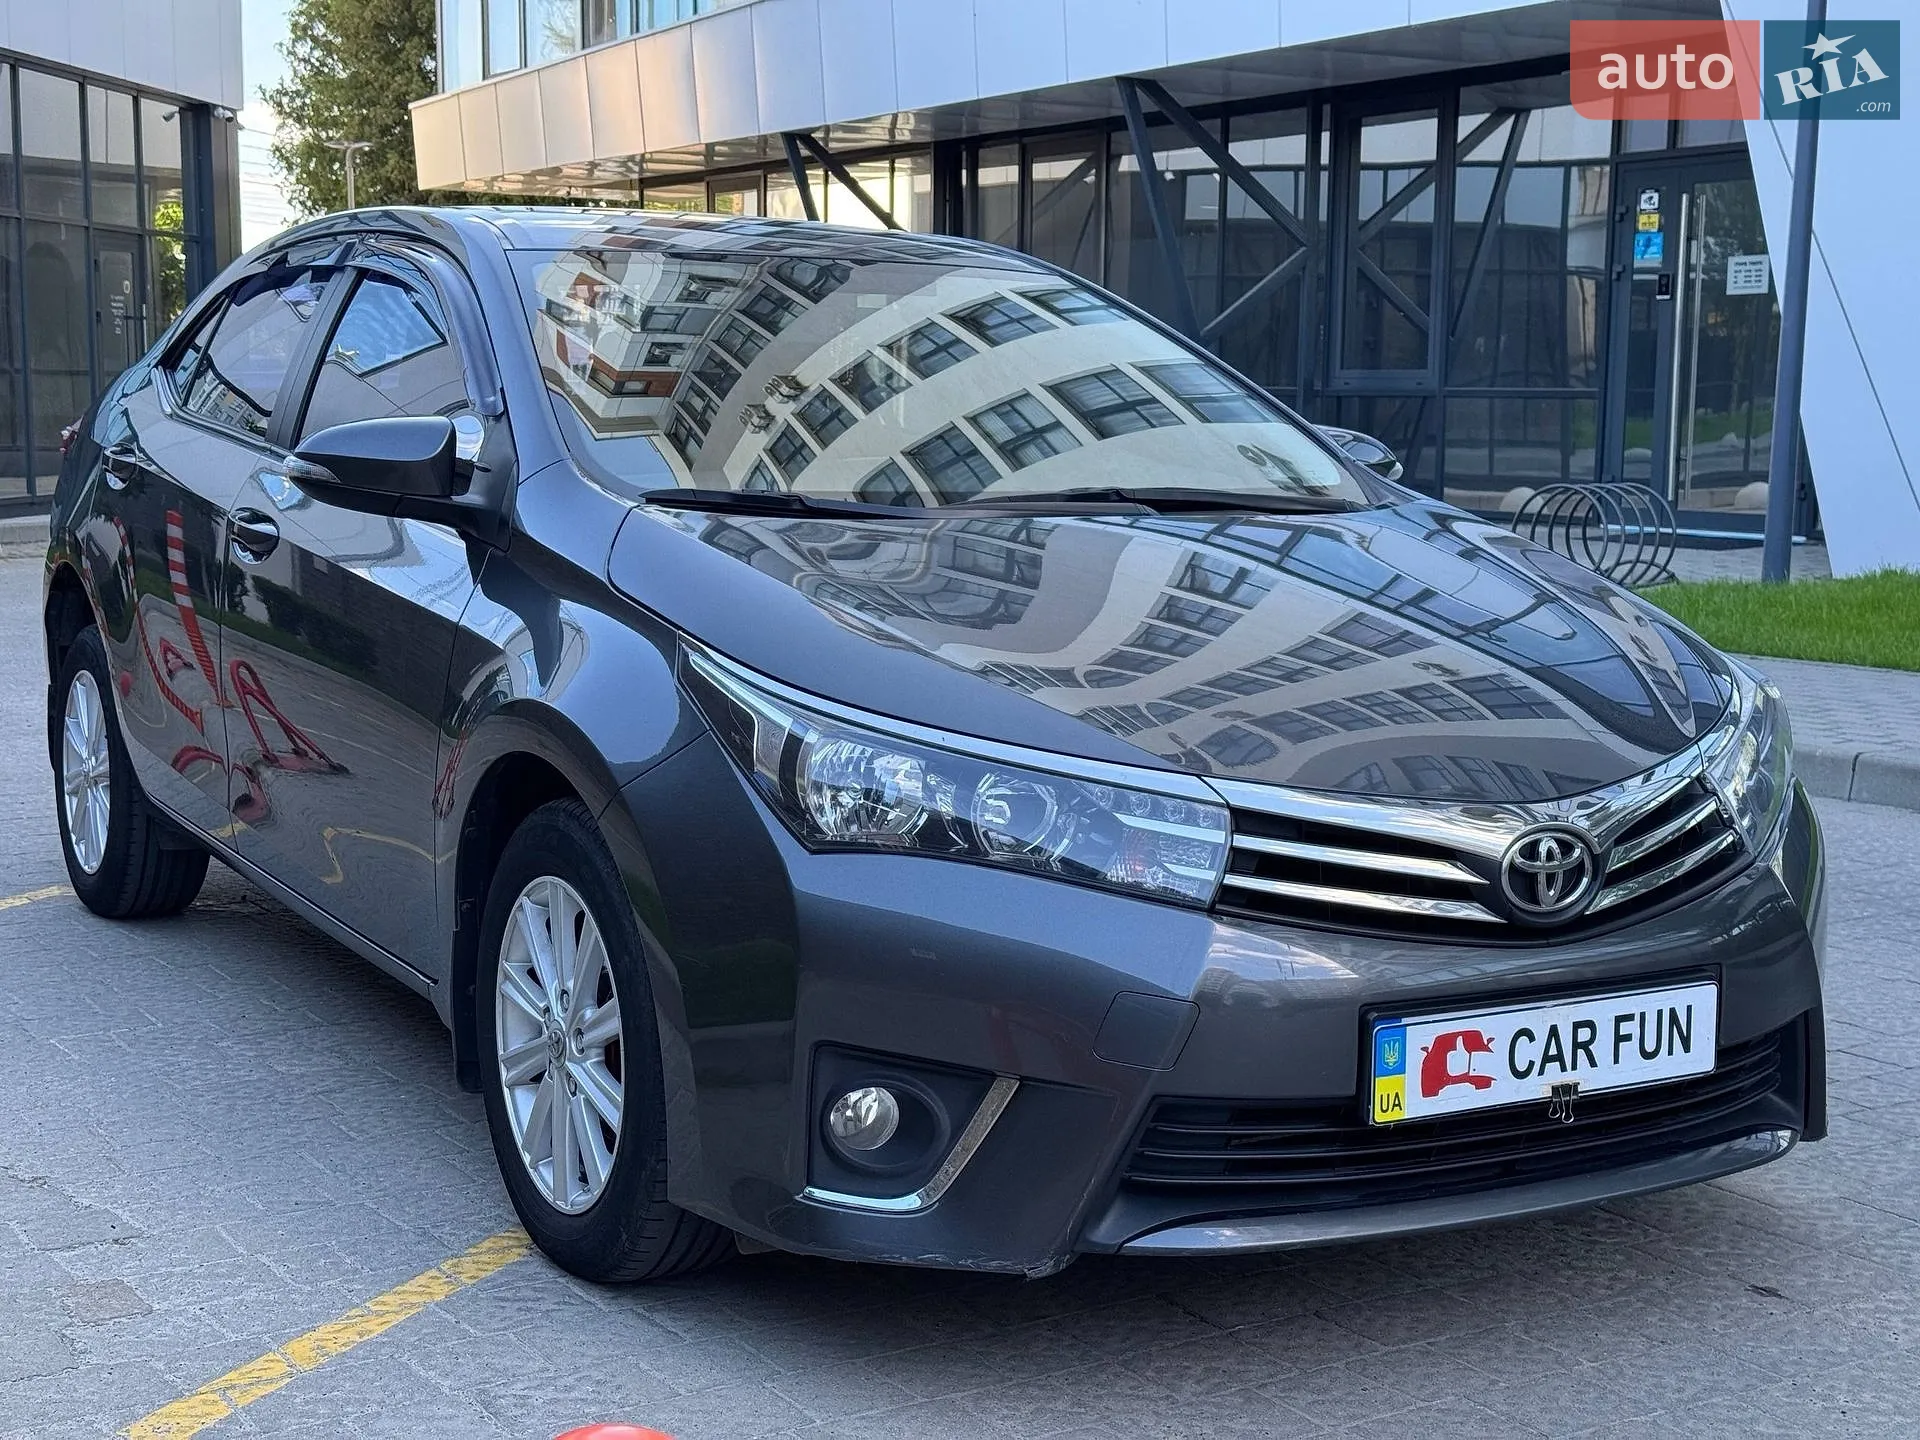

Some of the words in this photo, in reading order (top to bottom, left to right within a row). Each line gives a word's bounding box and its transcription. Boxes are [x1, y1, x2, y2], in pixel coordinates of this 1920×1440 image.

[1508, 1019, 1598, 1080] CAR
[1613, 1004, 1693, 1066] FUN
[1379, 1091, 1403, 1114] UA
